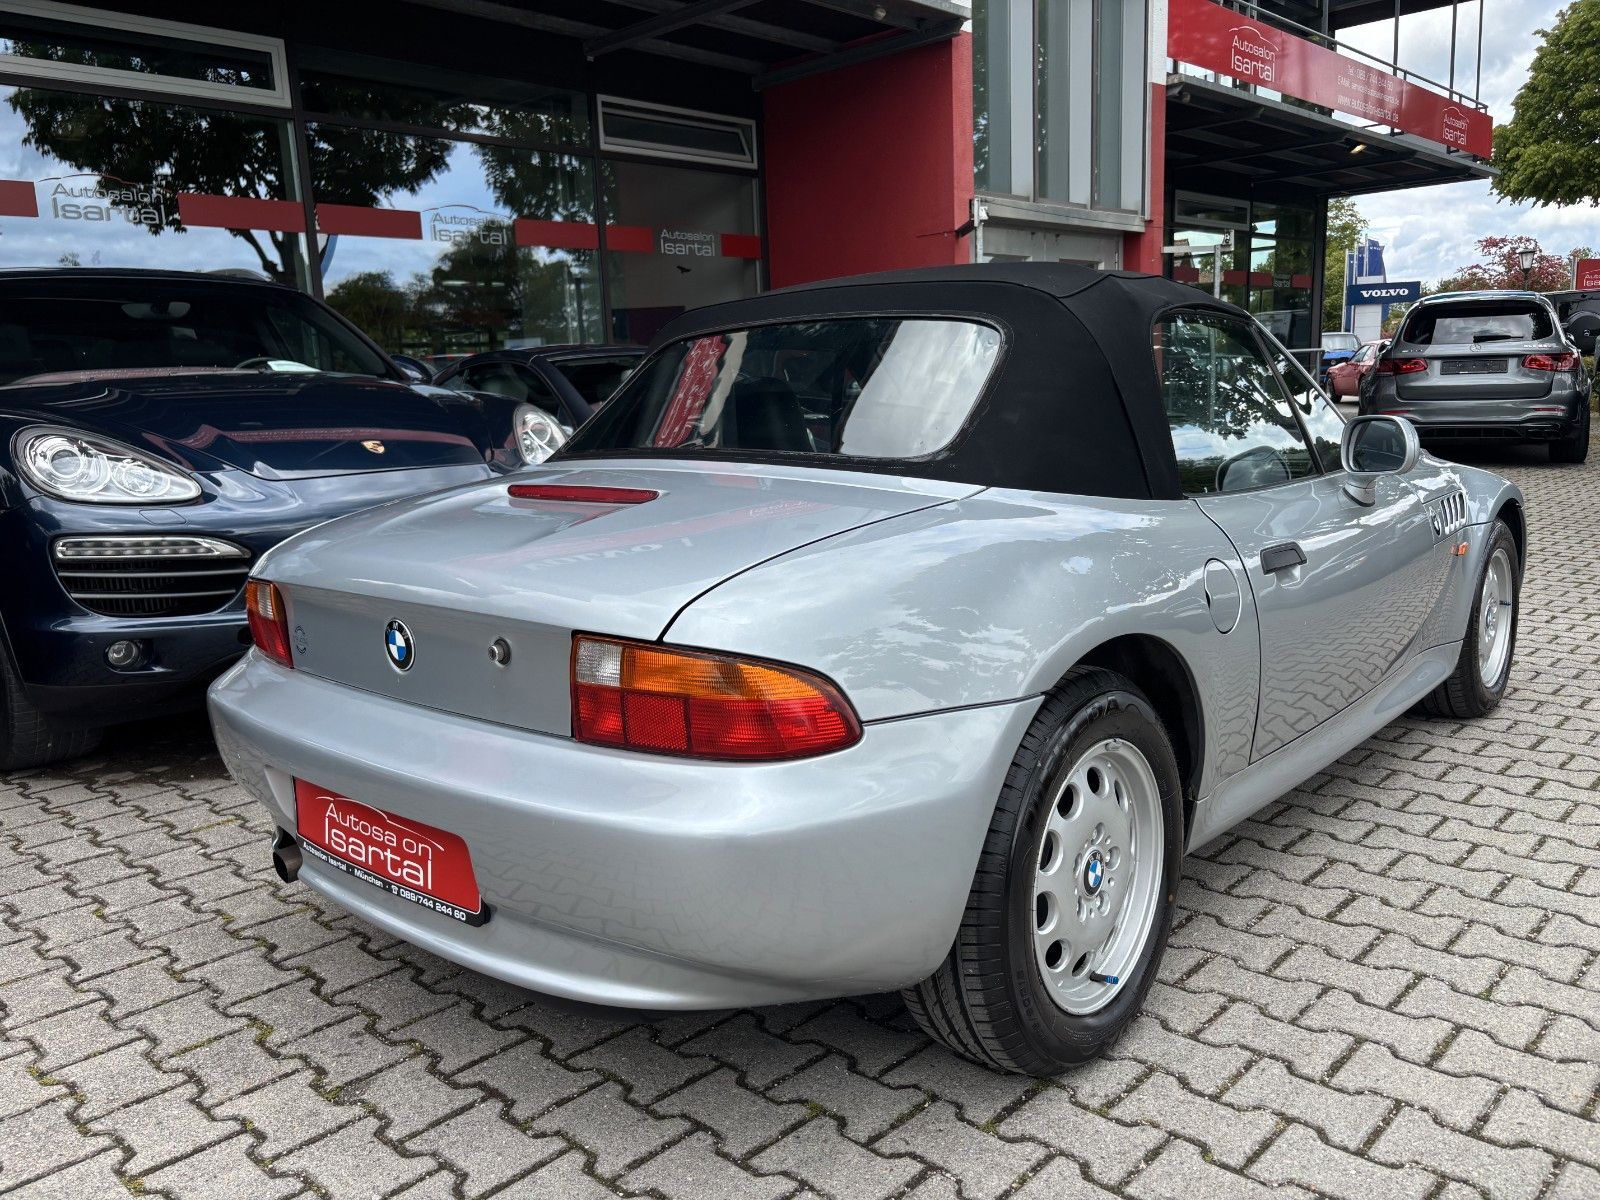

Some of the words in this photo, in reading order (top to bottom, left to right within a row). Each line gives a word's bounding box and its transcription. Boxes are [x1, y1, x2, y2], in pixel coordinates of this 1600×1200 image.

[1232, 35, 1275, 61] Autosalon
[1231, 48, 1275, 82] Isartal
[1443, 114, 1468, 130] Autosalon
[1442, 123, 1467, 145] Isartal
[51, 183, 164, 202] Autosalon
[52, 198, 166, 226] Isartal
[432, 212, 507, 228] Autosalon
[432, 224, 507, 245] Isartal
[660, 229, 714, 241] Autosalon
[660, 238, 715, 257] Isartal
[1360, 288, 1409, 298] VOLVO
[325, 803, 432, 860] Autosaon
[325, 817, 432, 890] Isartal
[328, 856, 347, 871] Isartal
[354, 868, 384, 888] München
[435, 902, 453, 916] 244
[453, 909, 467, 921] 60
